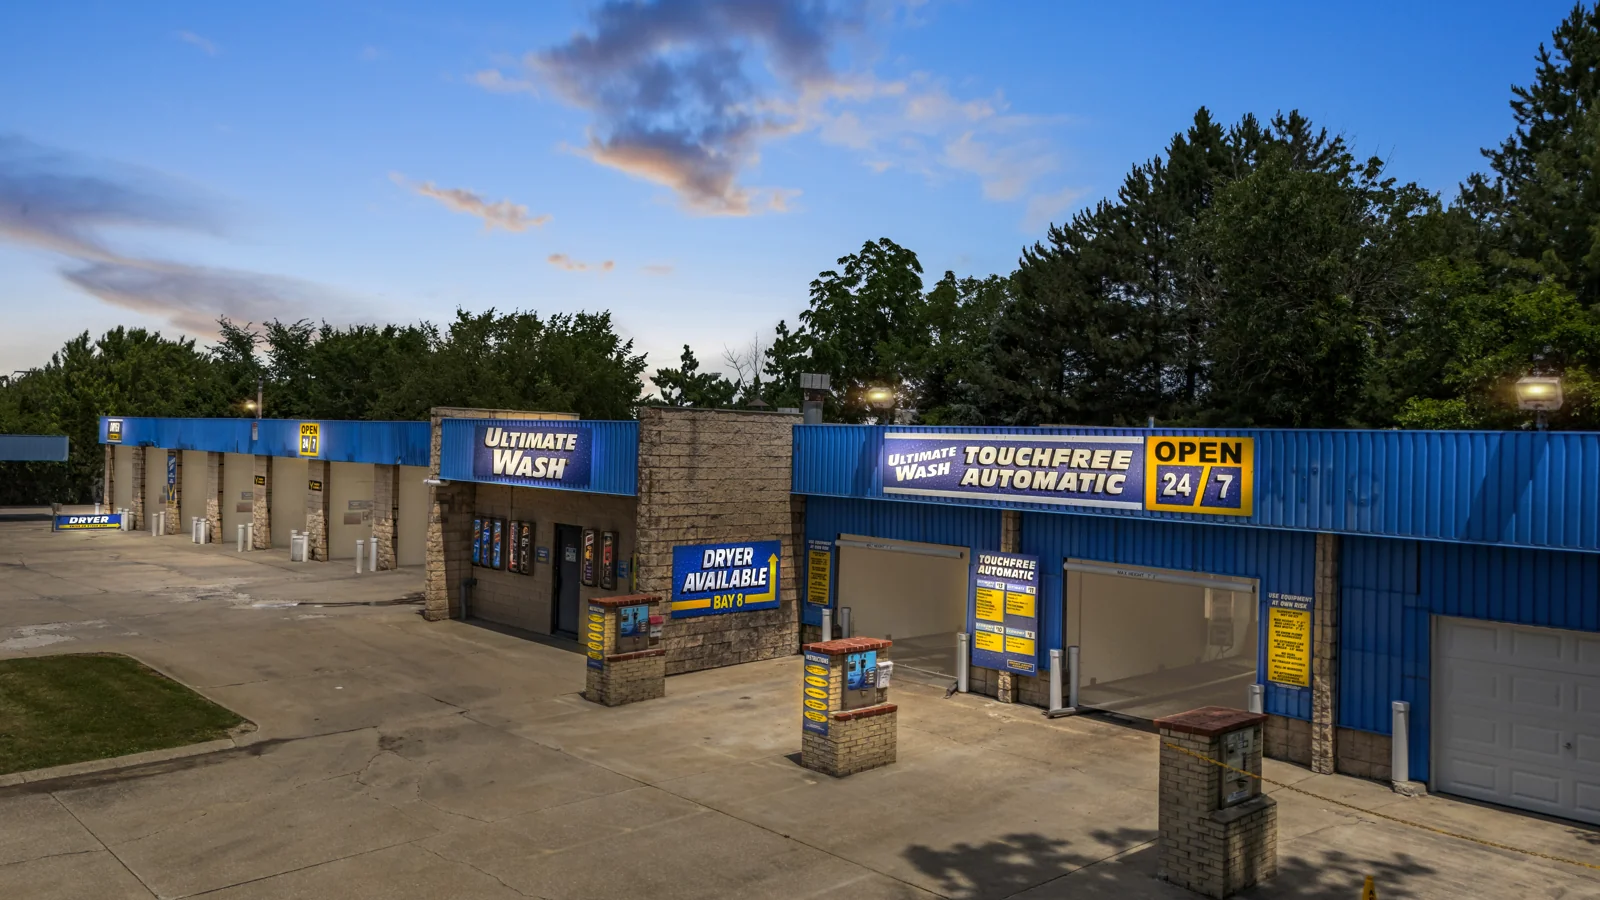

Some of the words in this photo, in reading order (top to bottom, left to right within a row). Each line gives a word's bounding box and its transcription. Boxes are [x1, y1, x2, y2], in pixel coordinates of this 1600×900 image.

[301, 425, 318, 435] OPEN
[484, 427, 578, 451] ULTIMATE
[887, 446, 957, 467] ULTIMATE
[962, 445, 1133, 470] TOUCHFREE
[1154, 441, 1243, 464] OPEN
[492, 449, 568, 480] WASH
[895, 462, 951, 482] WASH
[959, 468, 1127, 495] AUTOMATIC
[69, 516, 109, 524] DRYER
[702, 547, 754, 569] DRYER
[979, 554, 1036, 570] TOUCHFREE
[682, 567, 768, 593] AVAILABLE
[977, 565, 1034, 580] AUTOMATIC
[713, 595, 735, 610] BAY
[736, 593, 743, 607] 8
[1280, 594, 1313, 603] EQUIPMENT
